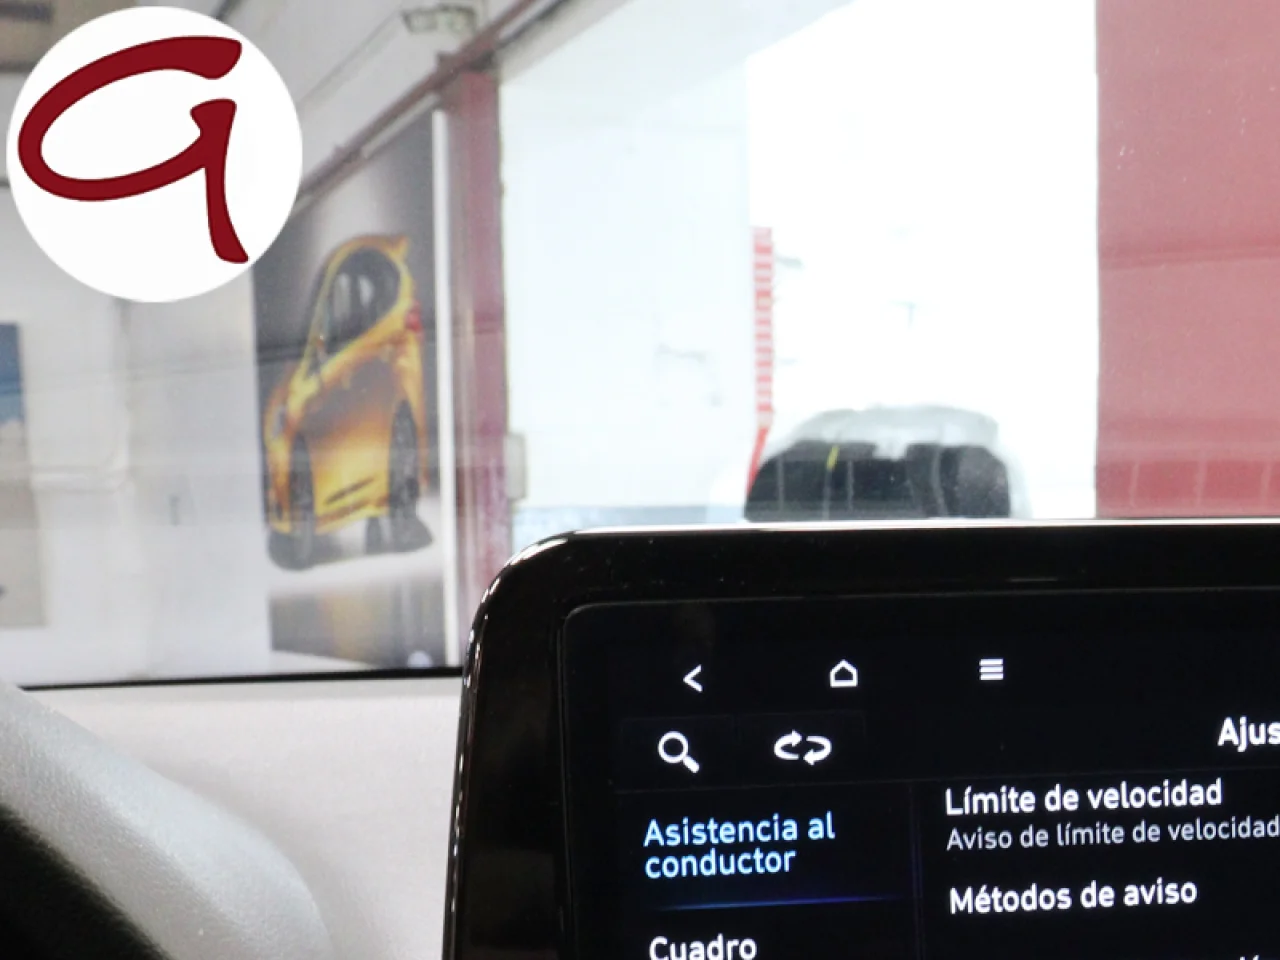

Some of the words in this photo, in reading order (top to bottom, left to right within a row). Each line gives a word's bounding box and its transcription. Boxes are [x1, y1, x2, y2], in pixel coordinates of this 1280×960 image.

[945, 785, 1036, 816] Límite
[1044, 783, 1080, 812] de
[1086, 777, 1224, 811] velocidad
[642, 814, 800, 846] Asistencia
[807, 810, 837, 841] al
[946, 826, 1013, 851] Aviso
[1019, 823, 1050, 849] de
[1056, 821, 1125, 847] límite
[1132, 819, 1162, 843] de
[644, 847, 797, 879] conductor
[949, 882, 1074, 915] Métodos
[1079, 879, 1116, 909] de
[1122, 876, 1199, 907] aviso
